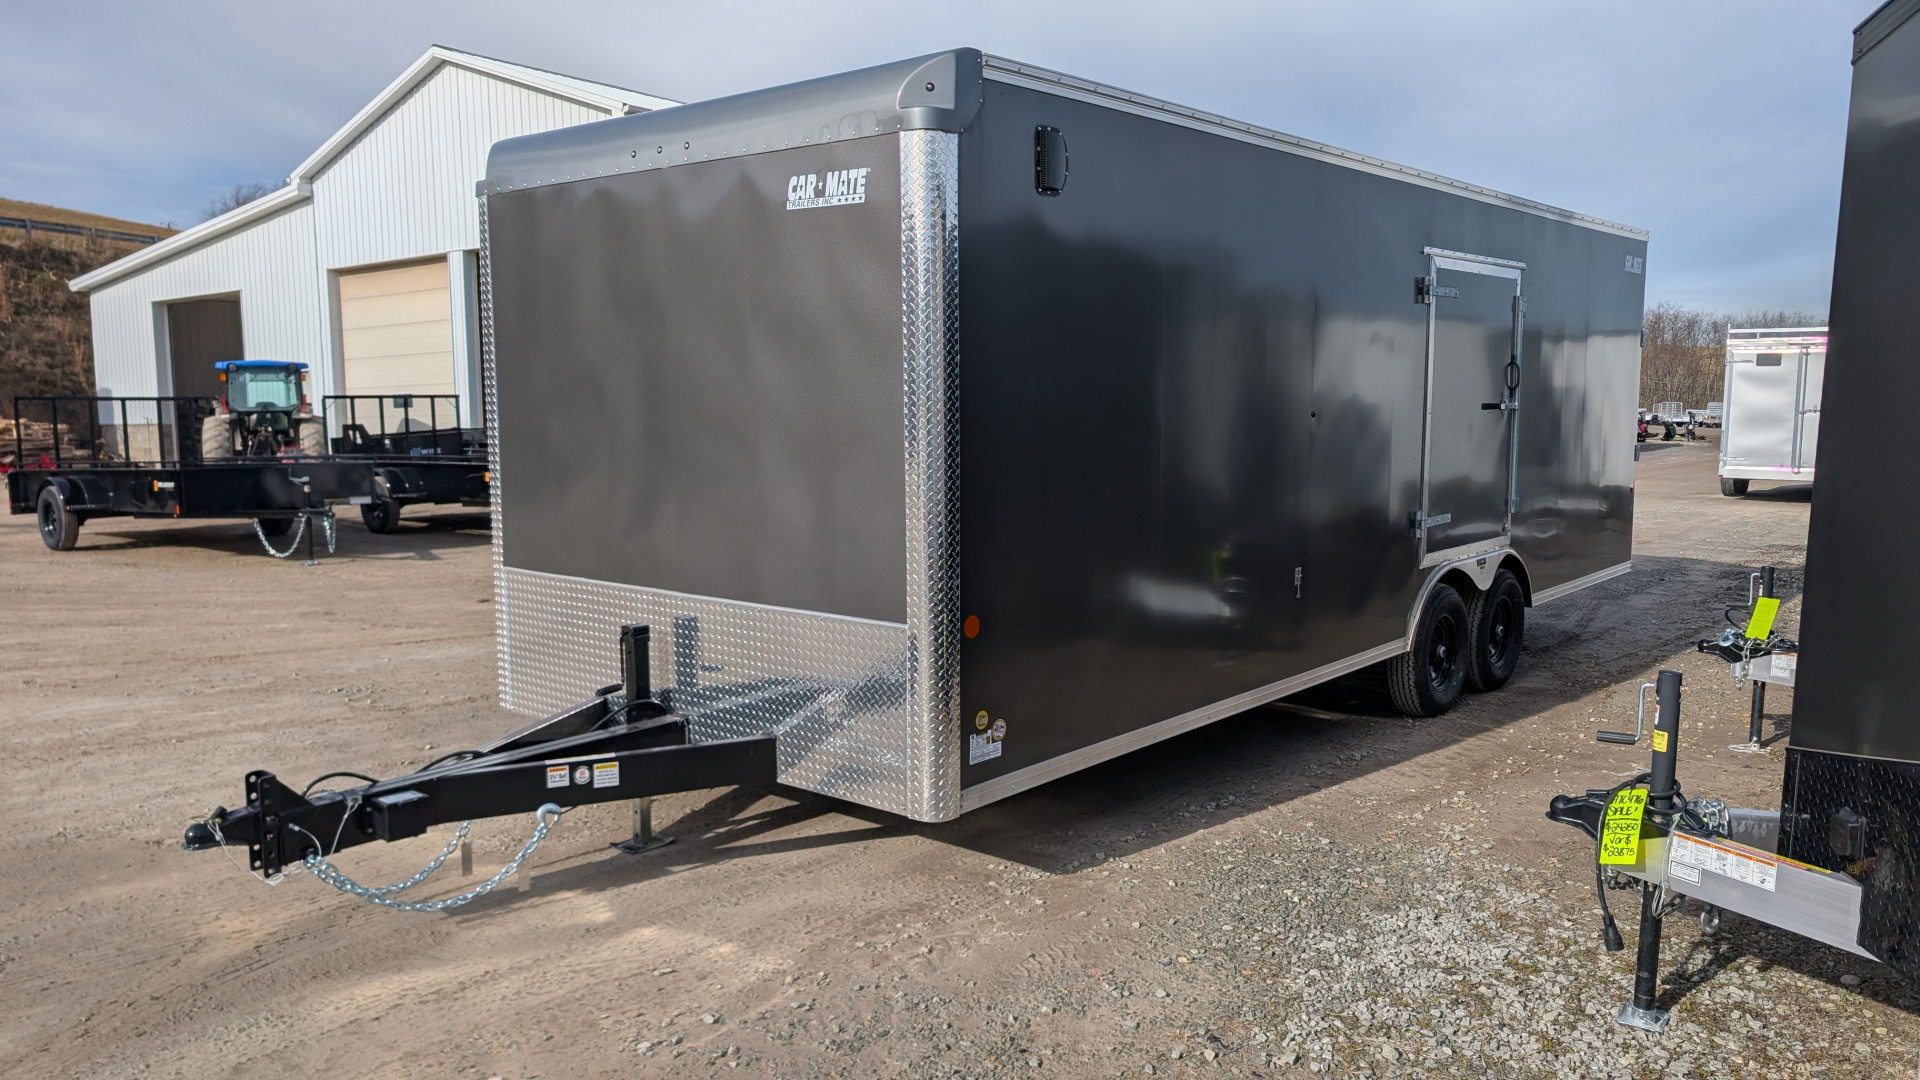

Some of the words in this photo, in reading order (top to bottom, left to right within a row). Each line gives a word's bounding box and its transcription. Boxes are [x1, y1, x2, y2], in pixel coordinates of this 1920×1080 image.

[788, 174, 817, 201] CAR
[825, 167, 868, 197] MATE
[788, 199, 820, 208] TRAILERS
[821, 197, 835, 205] INC.
[1607, 806, 1638, 817] SALE!
[1602, 843, 1636, 857] $23875
